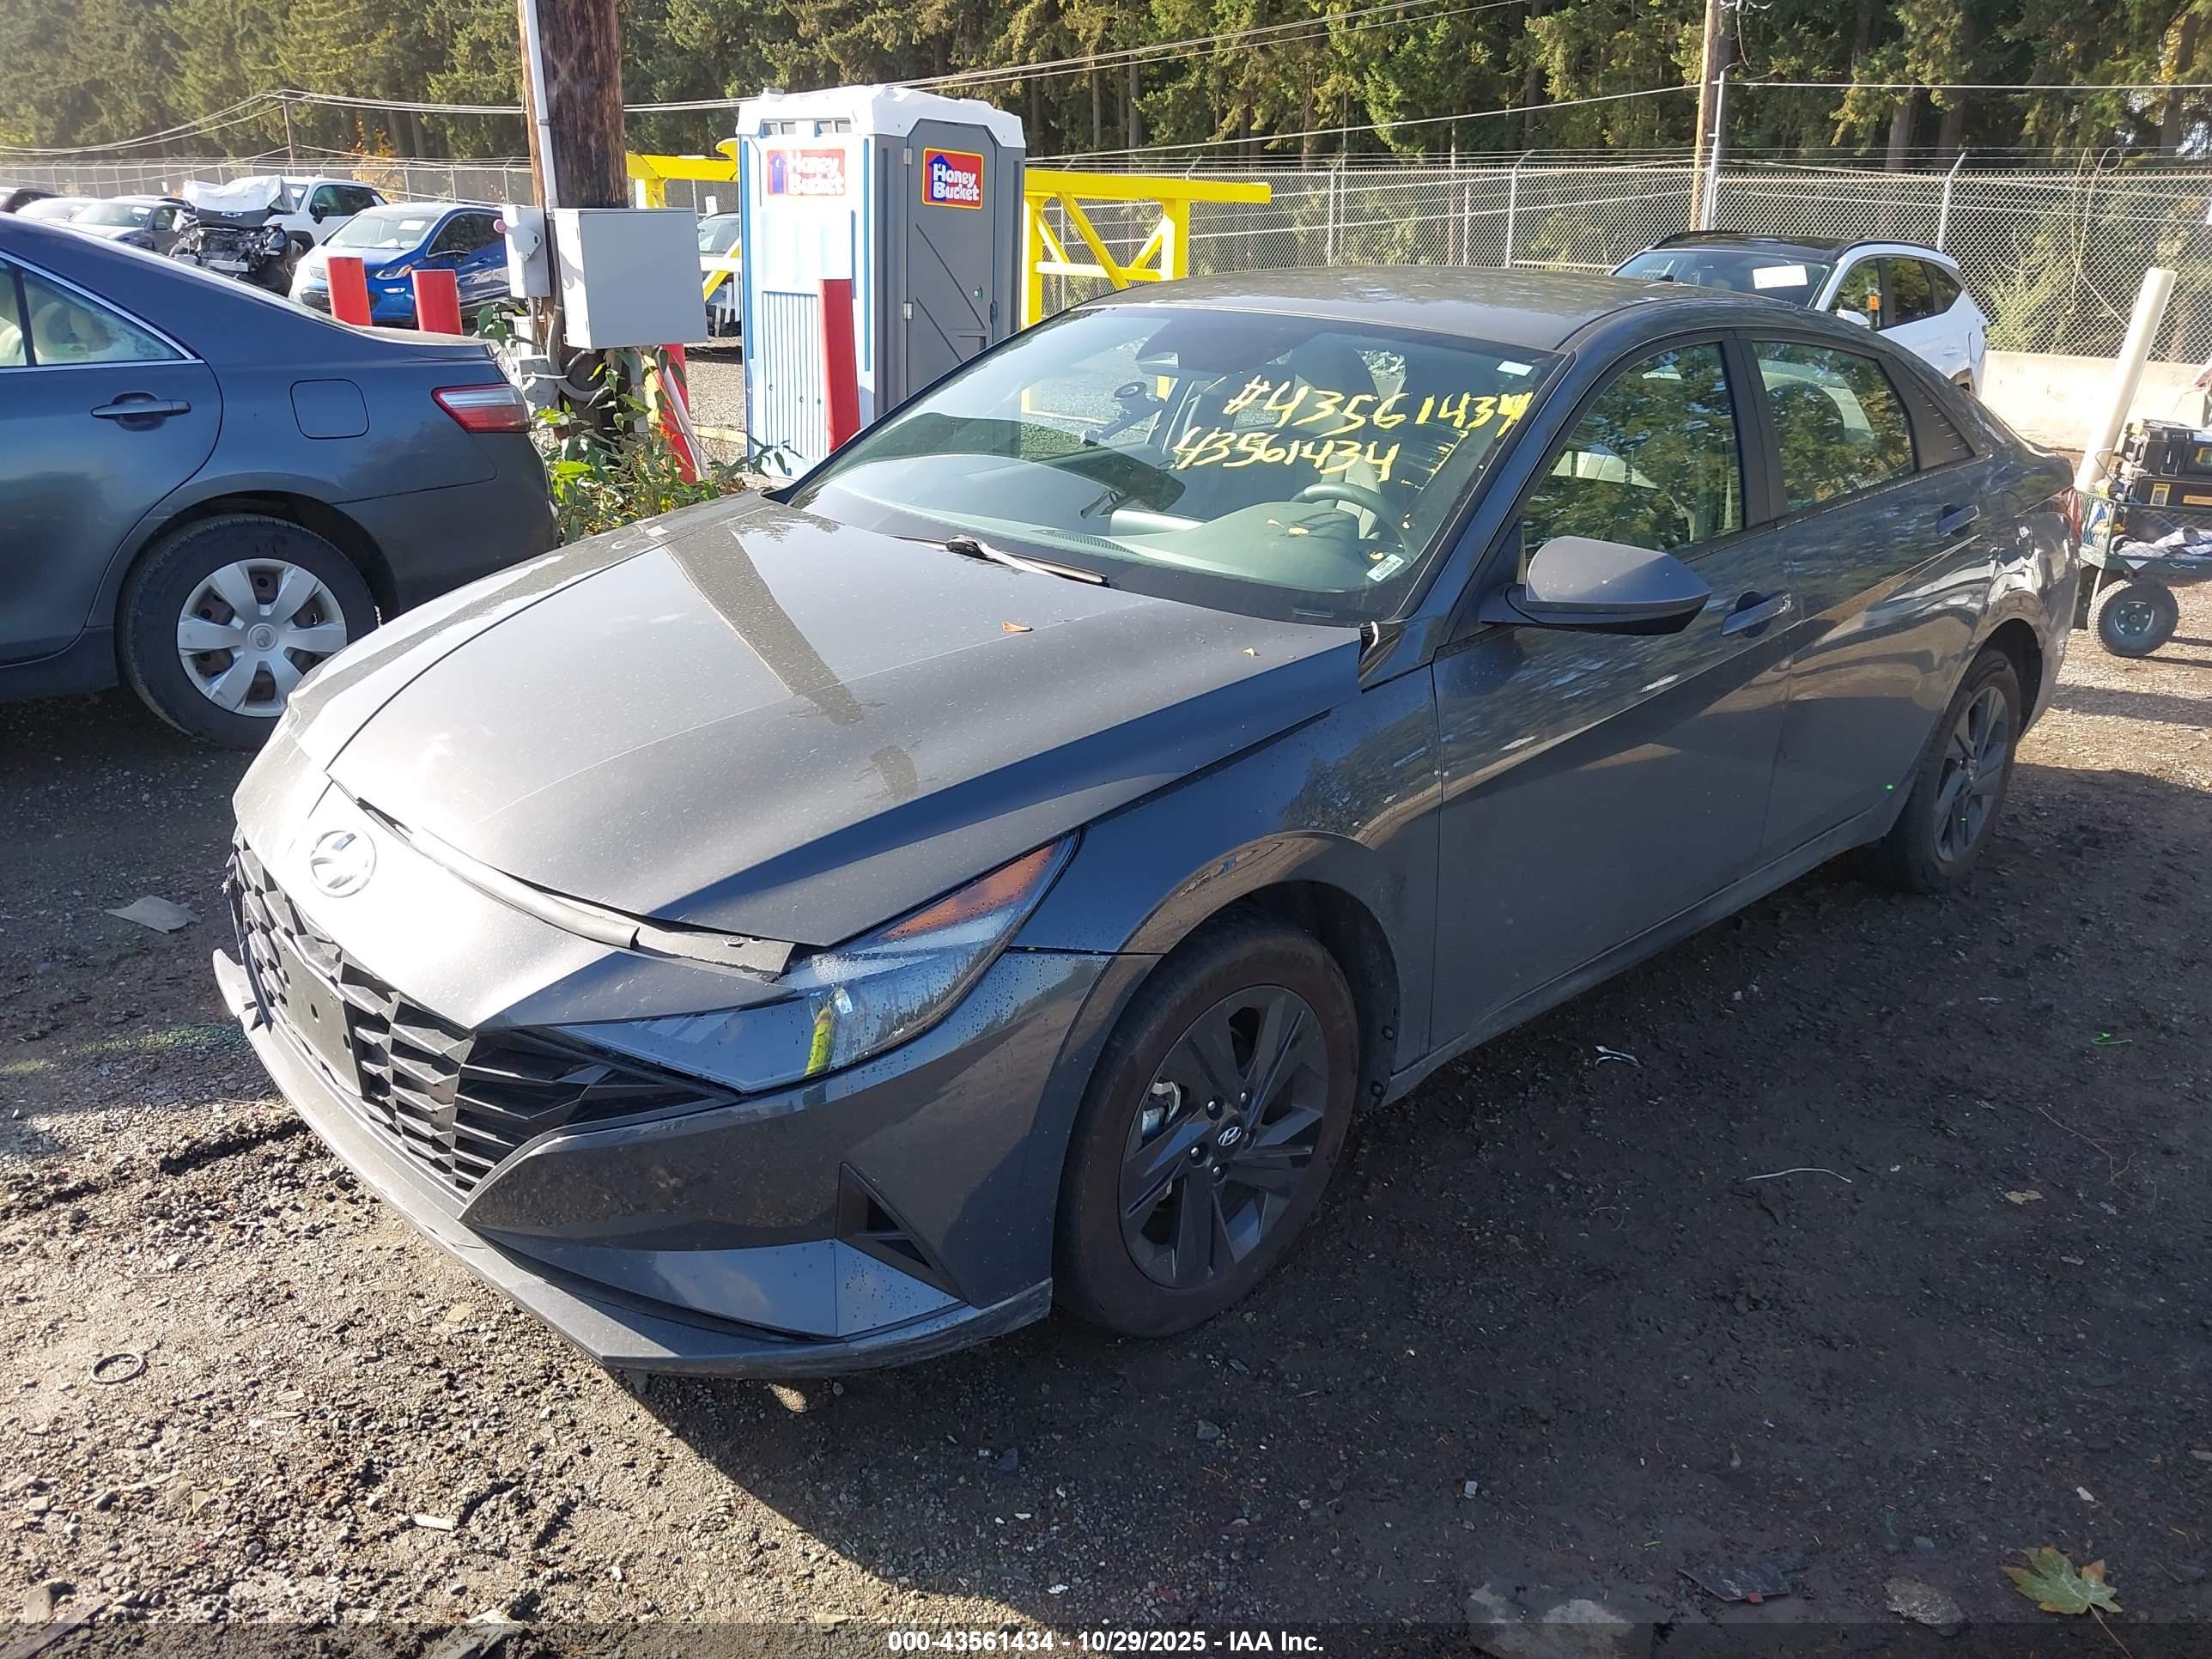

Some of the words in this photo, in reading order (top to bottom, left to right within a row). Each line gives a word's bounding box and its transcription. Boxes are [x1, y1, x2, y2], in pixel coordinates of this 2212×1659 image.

[933, 162, 976, 188] Honey
[933, 181, 980, 201] Bucket
[1171, 426, 1401, 483] 43561434
